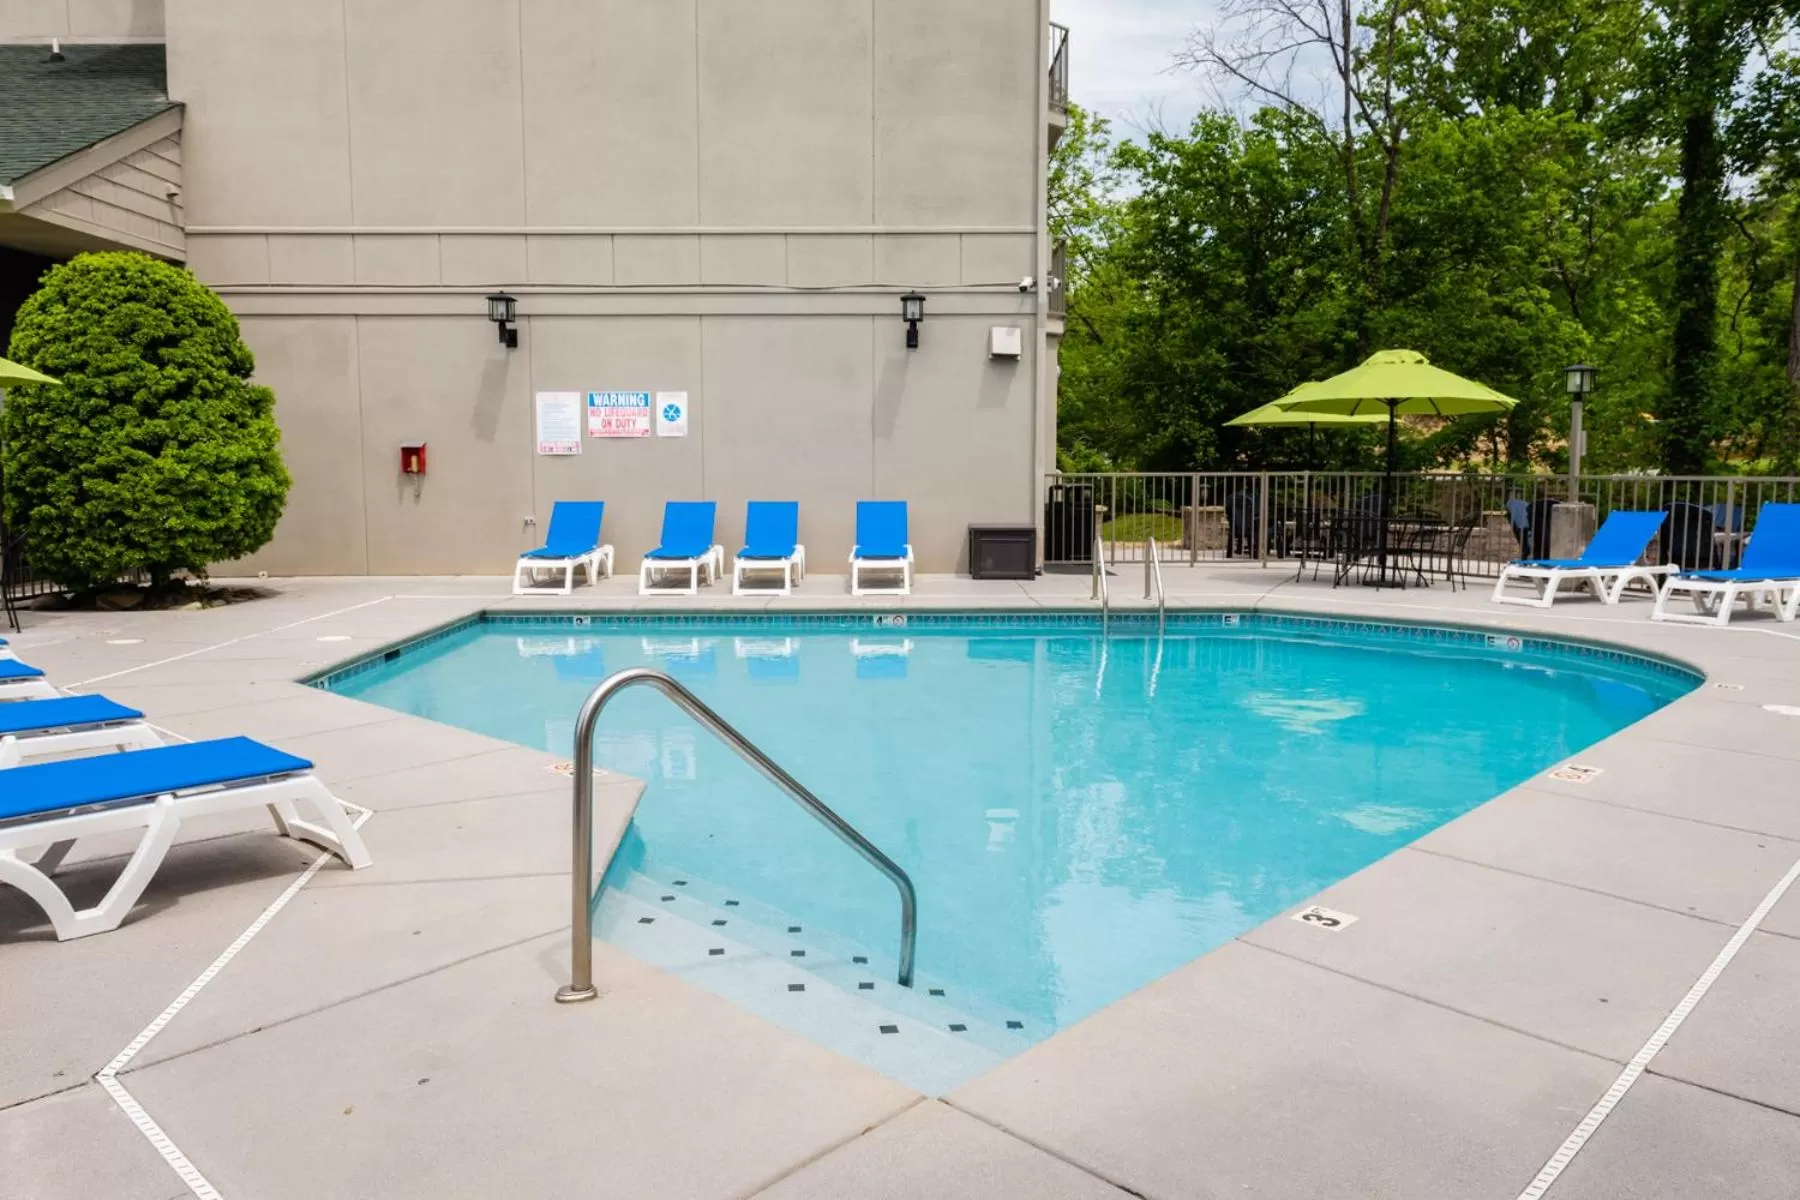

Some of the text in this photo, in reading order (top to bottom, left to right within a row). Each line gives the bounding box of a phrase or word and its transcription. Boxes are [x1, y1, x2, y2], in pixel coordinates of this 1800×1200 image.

[593, 393, 645, 407] WARNING
[590, 408, 648, 418] NO LIFEGUARD
[601, 418, 637, 429] ON DUTY
[1302, 913, 1341, 927] 3
